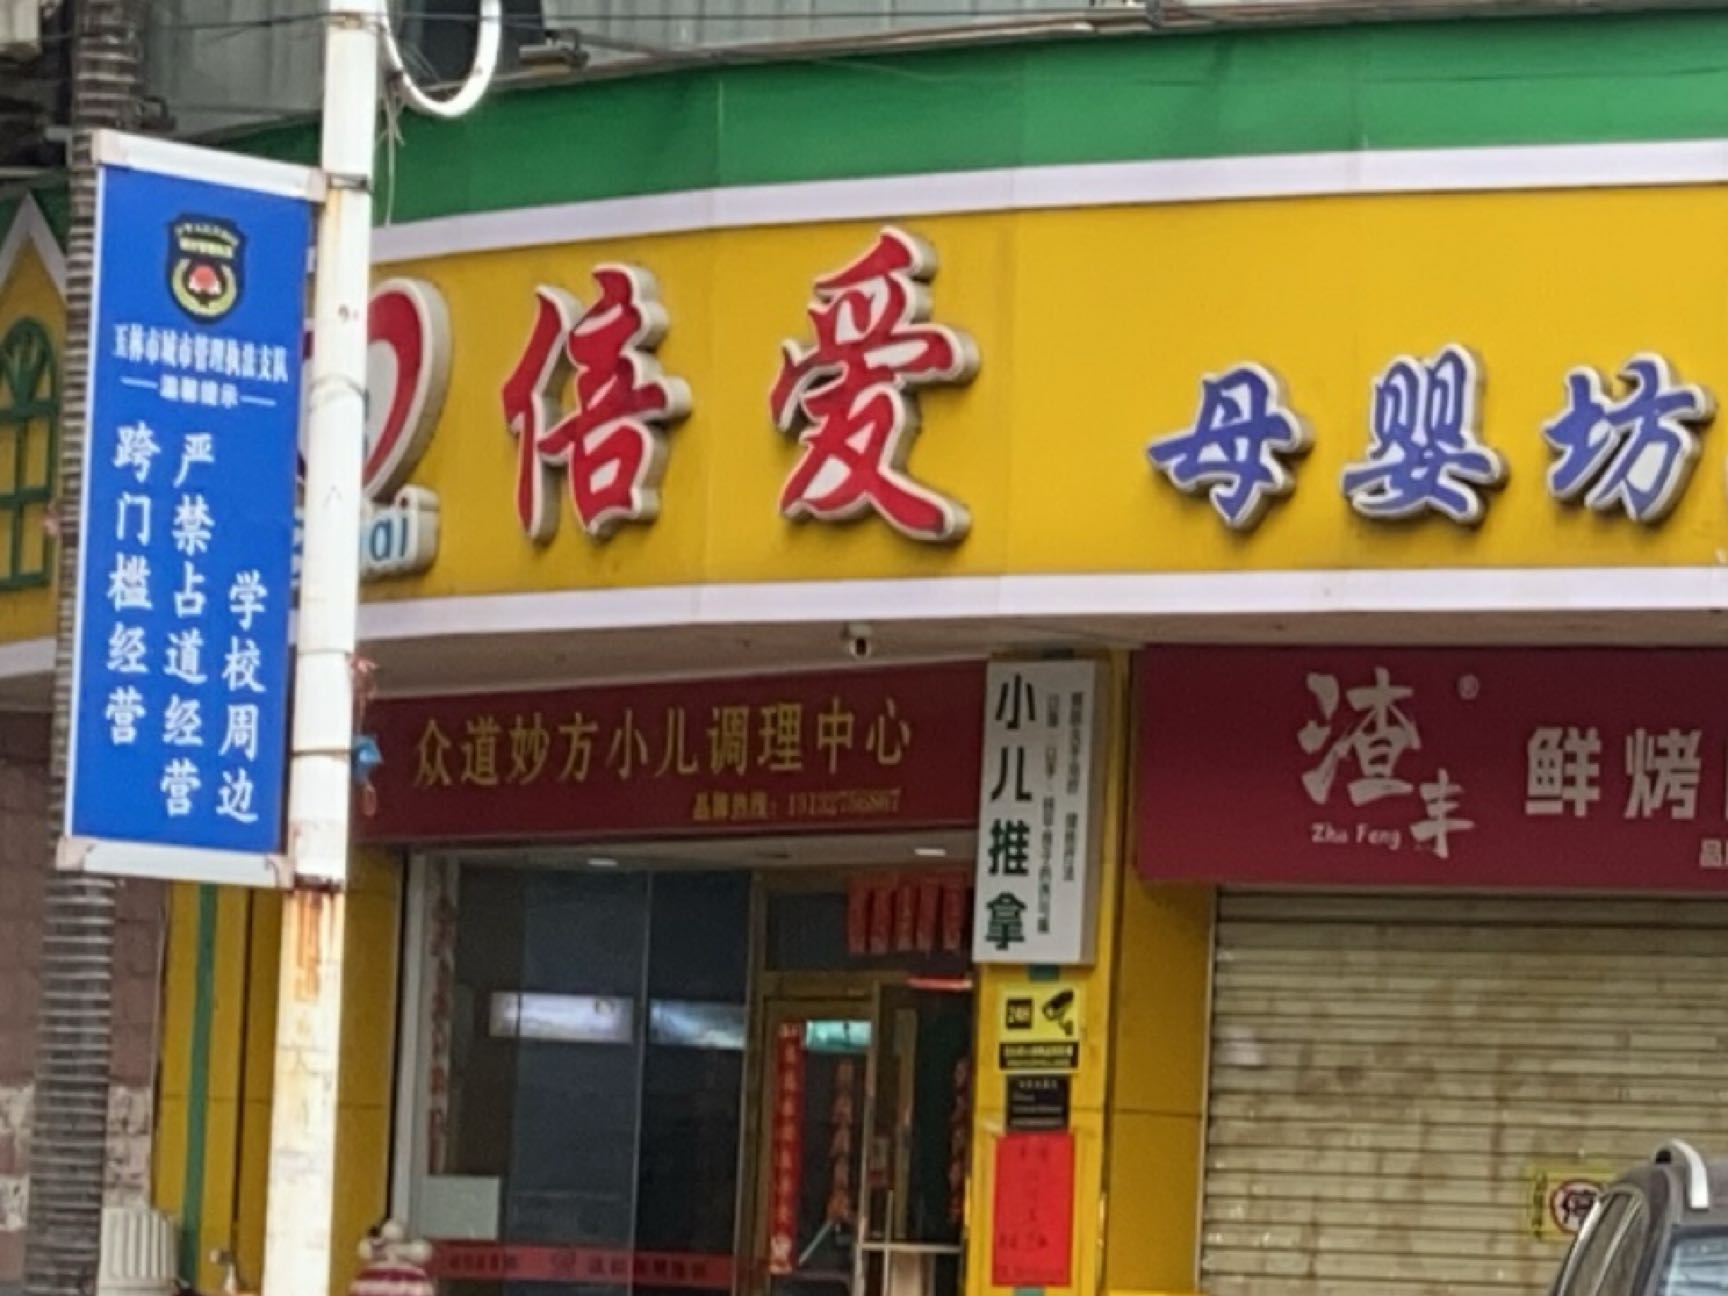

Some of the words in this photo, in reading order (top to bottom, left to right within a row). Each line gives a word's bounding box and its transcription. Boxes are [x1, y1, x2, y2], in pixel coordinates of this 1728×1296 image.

[500, 223, 981, 545] 倍爱
[1145, 343, 1717, 532] 母婴坊
[105, 420, 161, 747] 跨门槛经营
[160, 433, 217, 817] 严禁占道经营
[215, 569, 270, 823] 学校周边
[413, 696, 912, 788] 众道妙方小儿调理中心
[985, 672, 1037, 950] 小儿推拿
